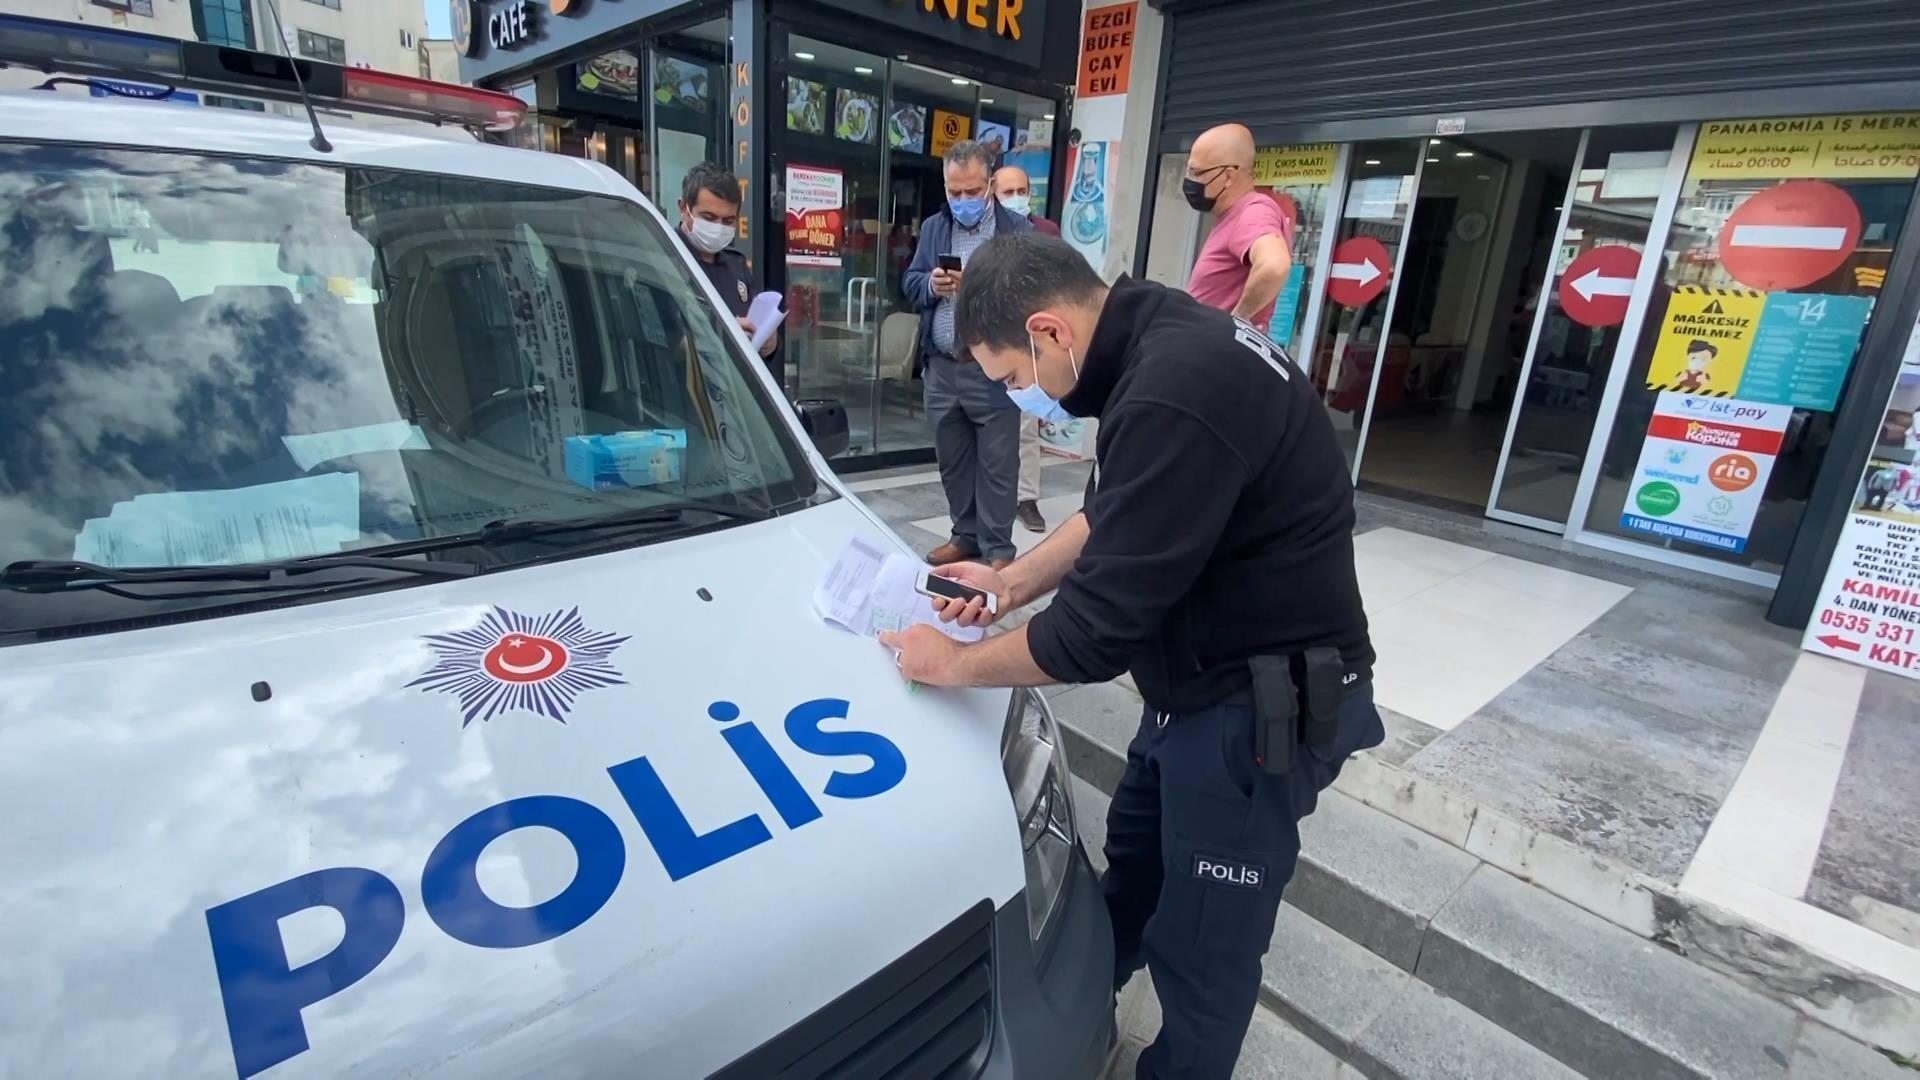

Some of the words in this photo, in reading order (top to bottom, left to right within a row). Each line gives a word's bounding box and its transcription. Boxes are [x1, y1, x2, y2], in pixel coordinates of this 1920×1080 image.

[488, 1, 528, 50] CAFE
[1090, 6, 1132, 30] EZGİ
[1086, 31, 1132, 52] BÜFE
[1088, 54, 1123, 74] ÇAY
[1089, 73, 1117, 94] EVİ
[1834, 117, 1851, 133] İŞ
[1746, 157, 1791, 168] 00:00
[808, 229, 836, 247] DÖNER
[1799, 298, 1827, 322] 14
[1672, 313, 1750, 330] MASKESİZ
[1714, 459, 1750, 480] ria
[1856, 544, 1906, 560] KARATE
[1849, 598, 1879, 614] DAN
[1820, 609, 1871, 634] 0535
[1875, 621, 1915, 645] 331
[1198, 861, 1260, 885] POLİS
[205, 698, 906, 1080] POLİS
